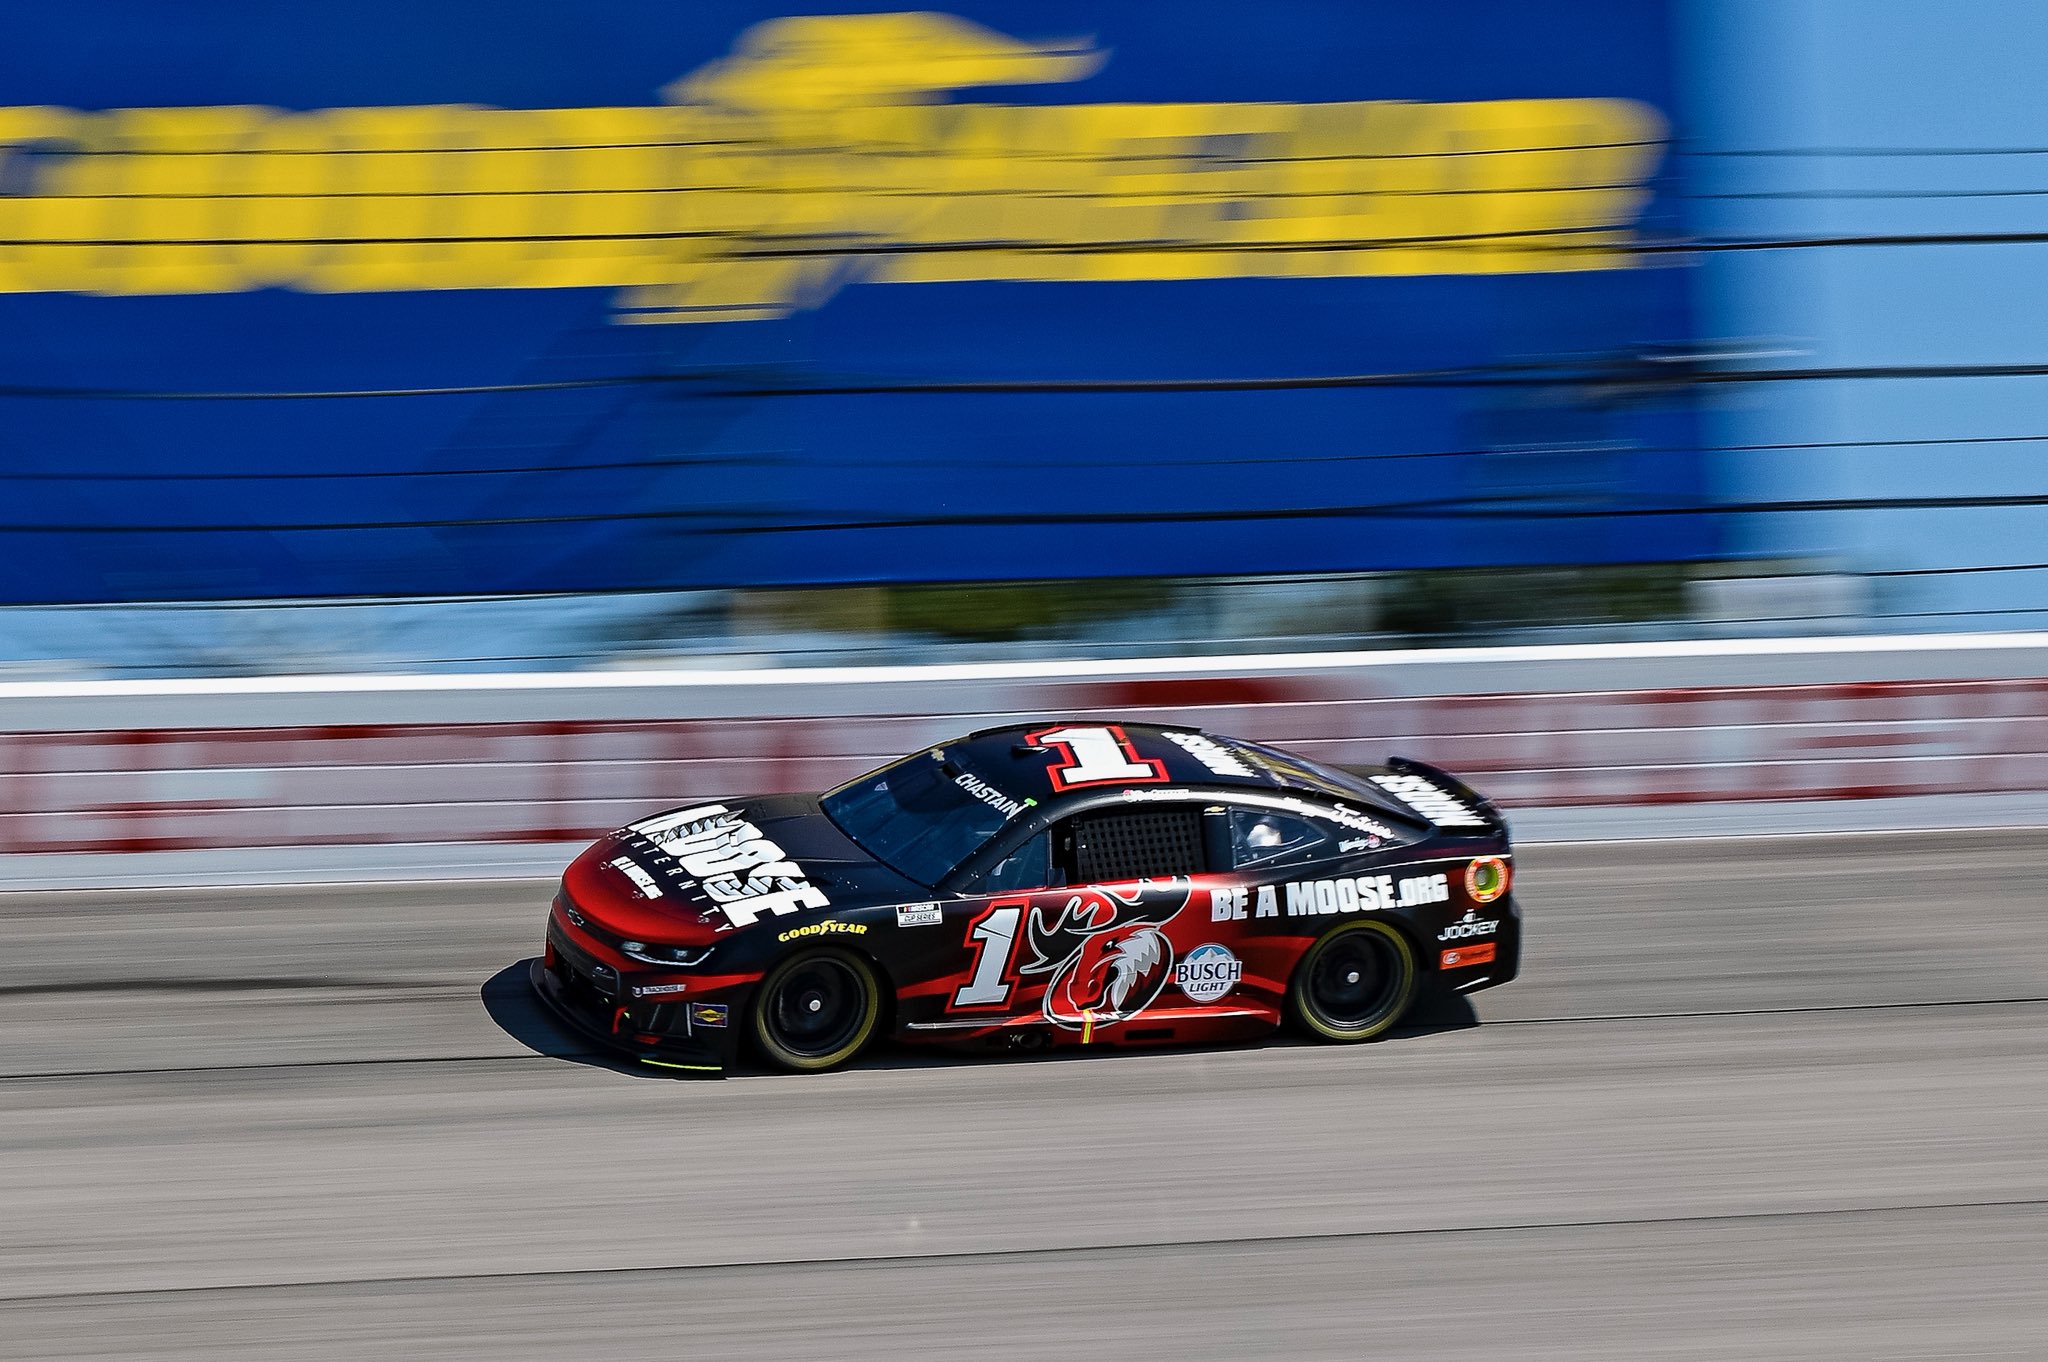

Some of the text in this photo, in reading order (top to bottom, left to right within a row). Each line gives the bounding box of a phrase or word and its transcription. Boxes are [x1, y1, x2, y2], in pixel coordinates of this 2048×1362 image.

[1032, 726, 1162, 788] 1
[955, 773, 1019, 818] CHASTAIN
[1209, 887, 1249, 922] BE
[1255, 885, 1279, 918] A
[778, 920, 867, 942] GOODYEAR
[1437, 920, 1500, 940] JOCKEY
[949, 902, 1025, 1009] 1
[1177, 962, 1240, 982] BUSCH
[1189, 982, 1227, 993] LIGHT
